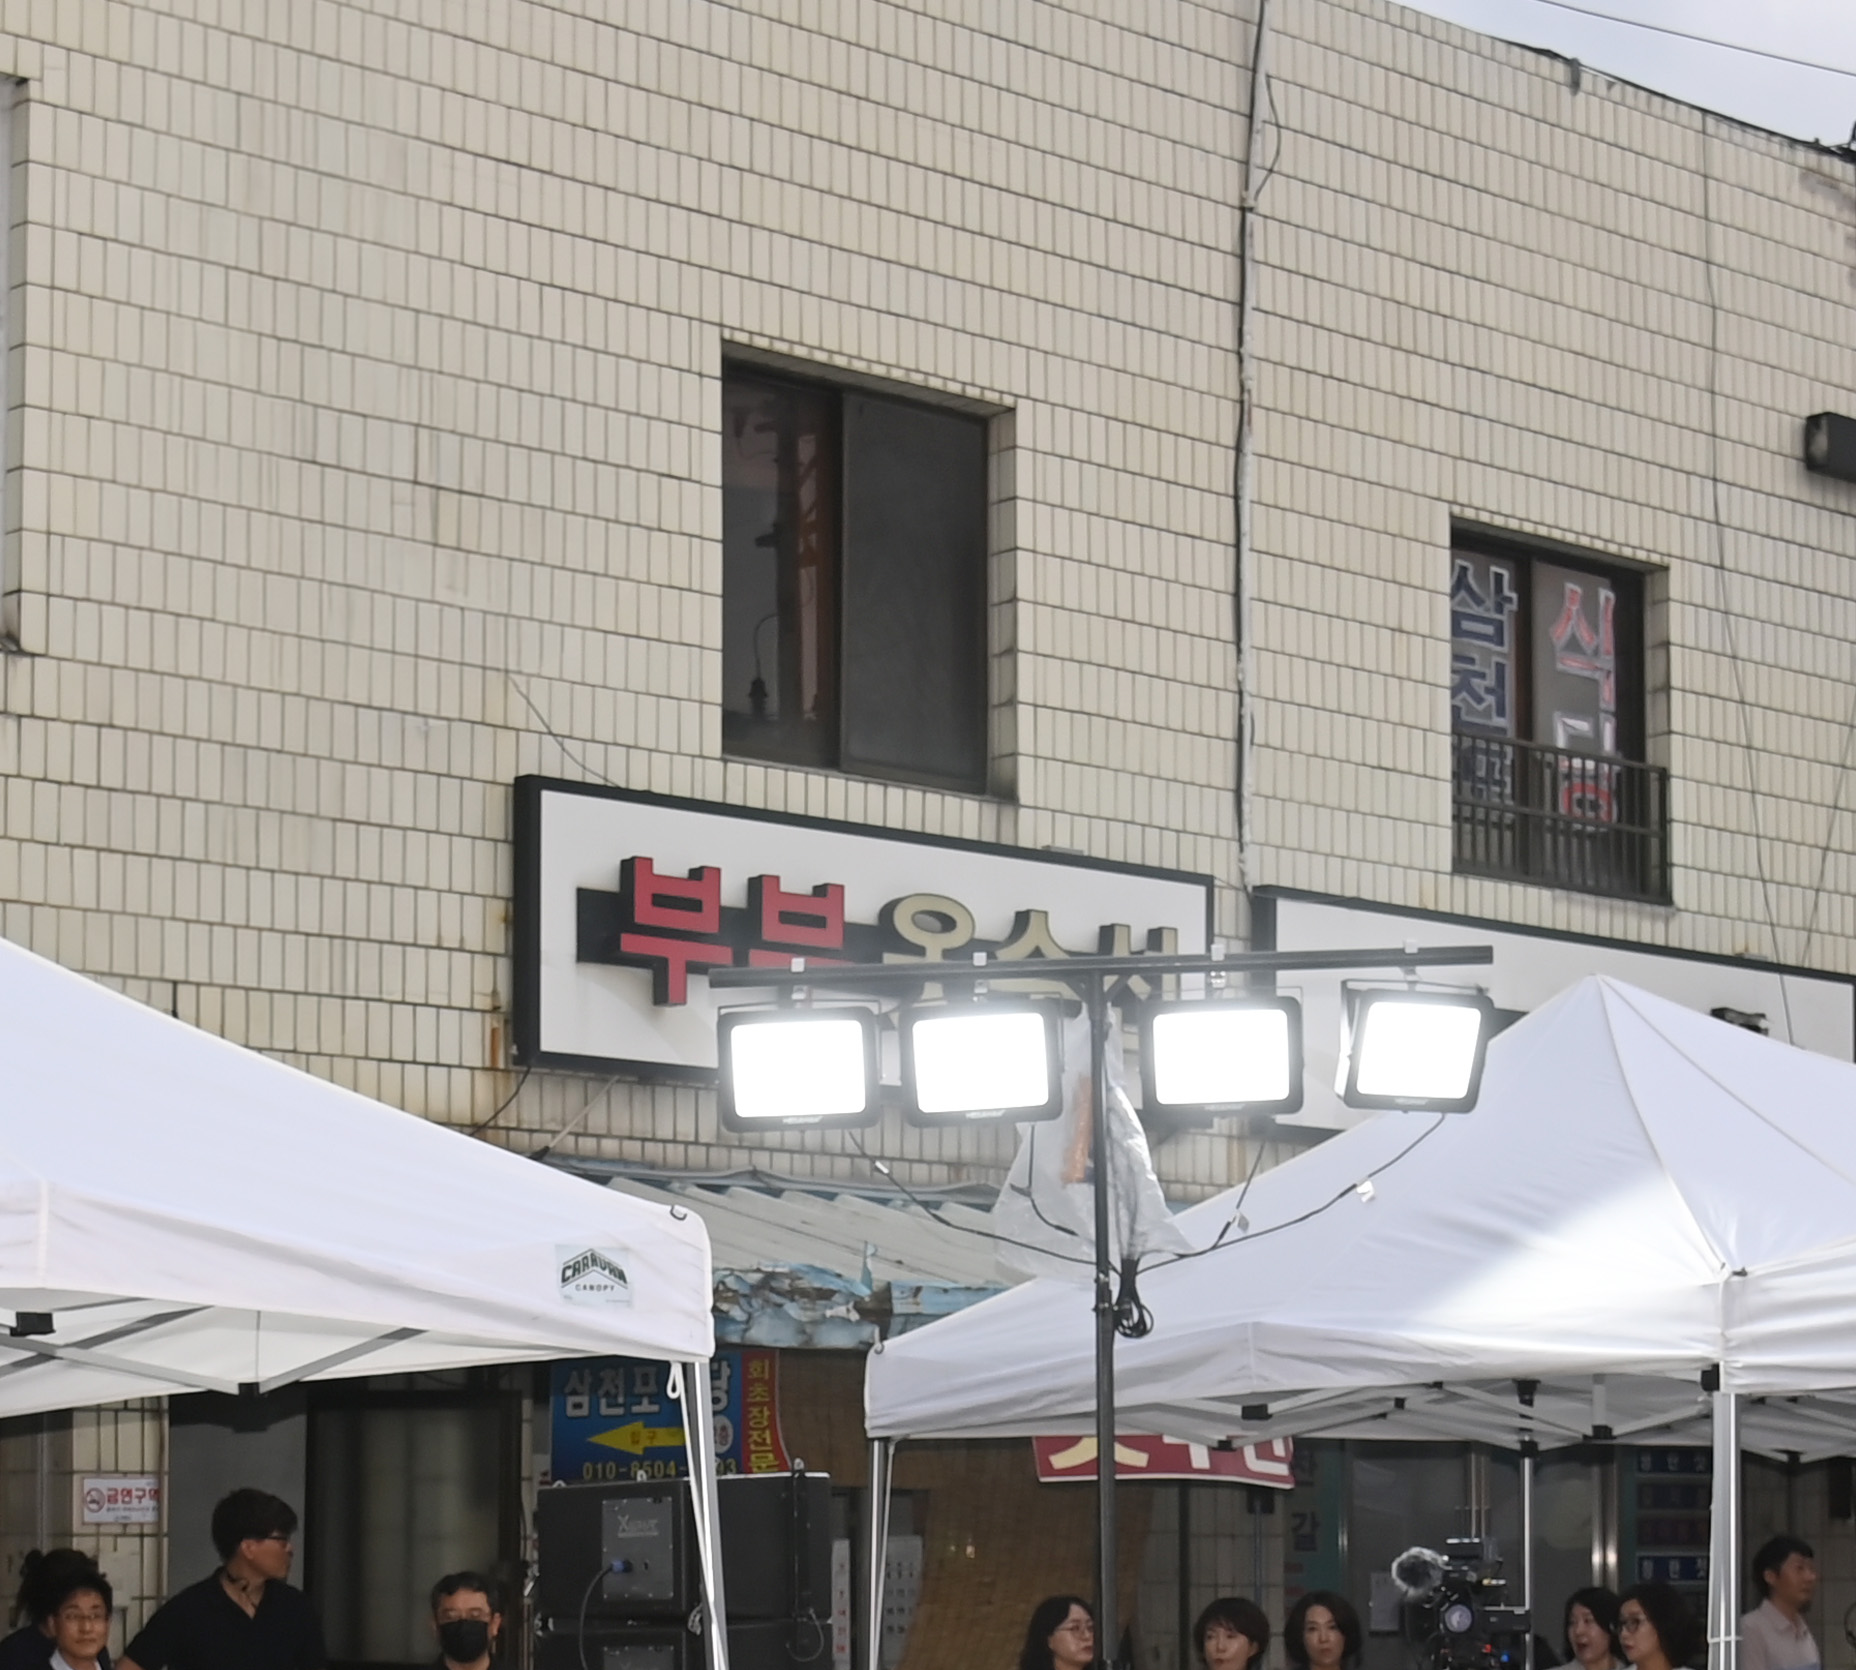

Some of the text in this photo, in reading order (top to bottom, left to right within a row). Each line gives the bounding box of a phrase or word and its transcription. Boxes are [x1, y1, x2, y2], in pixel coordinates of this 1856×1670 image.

[1550, 582, 1618, 832] 식당
[561, 1252, 628, 1284] CARAVAN
[575, 1284, 615, 1292] CANOPY
[563, 1366, 661, 1418] 삼천포
